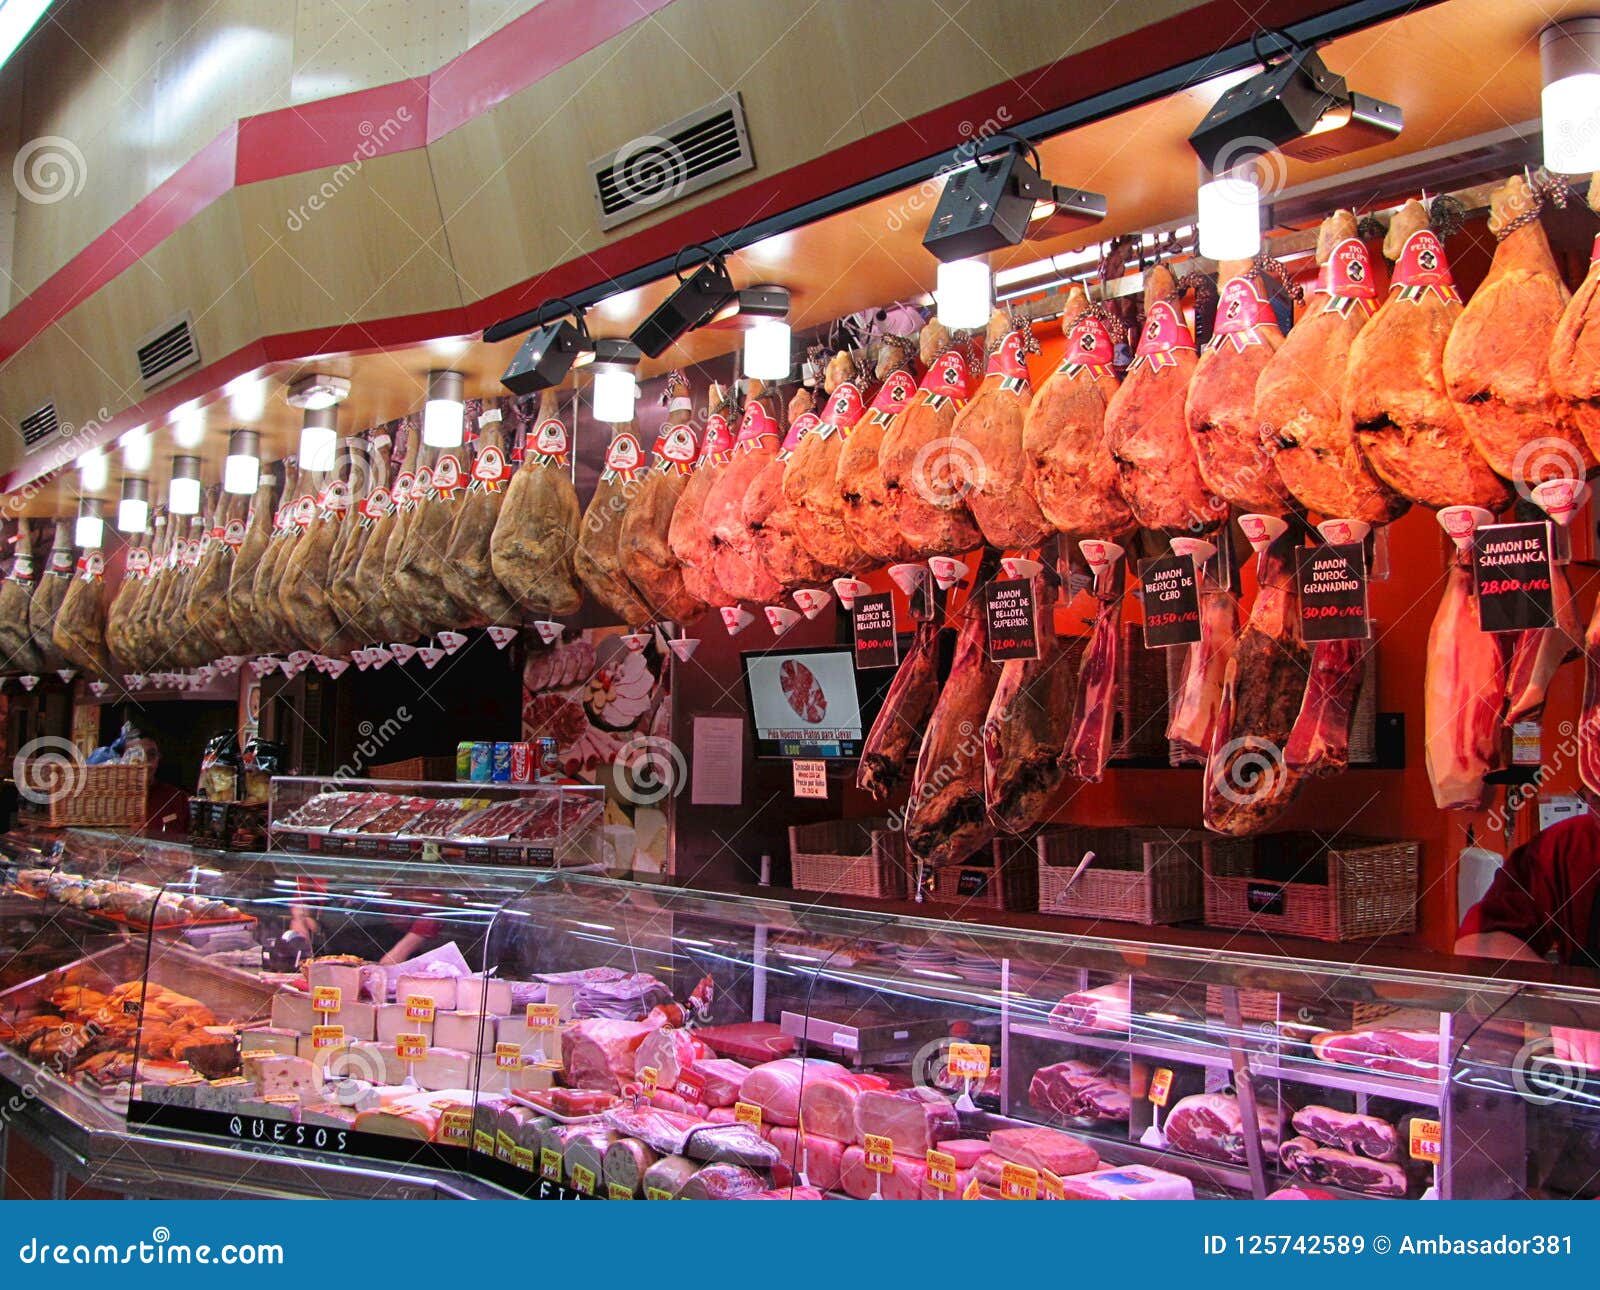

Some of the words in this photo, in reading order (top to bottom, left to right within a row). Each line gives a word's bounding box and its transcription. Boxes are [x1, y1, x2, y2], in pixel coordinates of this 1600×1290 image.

[1483, 540, 1522, 554] JAMON
[1525, 538, 1541, 550] DE
[1312, 558, 1347, 571] JAMON
[1479, 551, 1547, 567] SALAMANCA
[1154, 568, 1182, 581] JAMON
[1312, 569, 1348, 581] DUROC
[1145, 580, 1177, 593] IBERICO
[1181, 577, 1193, 587] DE
[1303, 580, 1358, 594] GRANADINO
[996, 589, 1021, 600] JAMON
[1159, 590, 1181, 602] CEBO
[993, 618, 1029, 629] SUPERIOR
[229, 1115, 346, 1150] QUESOS
